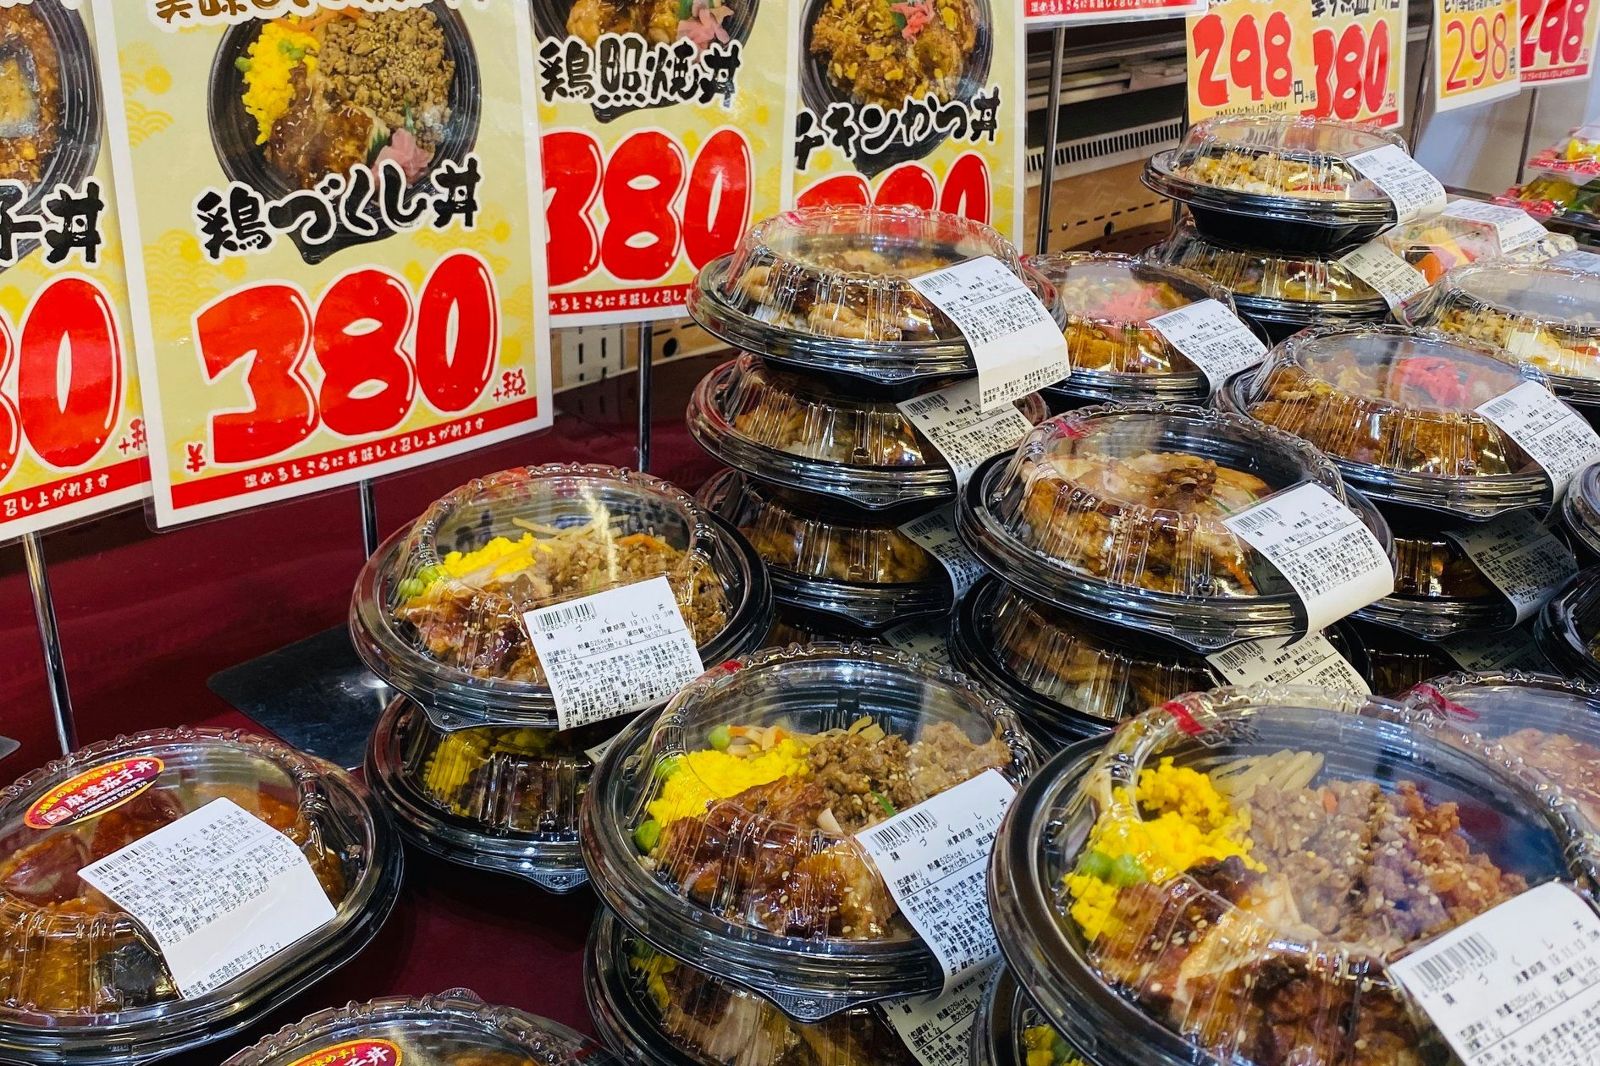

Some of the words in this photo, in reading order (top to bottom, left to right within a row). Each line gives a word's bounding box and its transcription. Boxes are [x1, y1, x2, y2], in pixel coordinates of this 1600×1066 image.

[539, 37, 741, 108] 鶏照焼丼
[1193, 11, 1292, 107] 298
[1446, 12, 1507, 91] 298
[794, 86, 1001, 170] チキンかつ丼
[196, 160, 481, 258] 鶏づくし丼
[541, 130, 752, 285] 380
[0, 278, 123, 481] 0
[198, 254, 498, 463] 380
[244, 417, 485, 488] 温めるとさらに美味しく召し上がれます
[64, 760, 153, 807] 麻婆茄子丼
